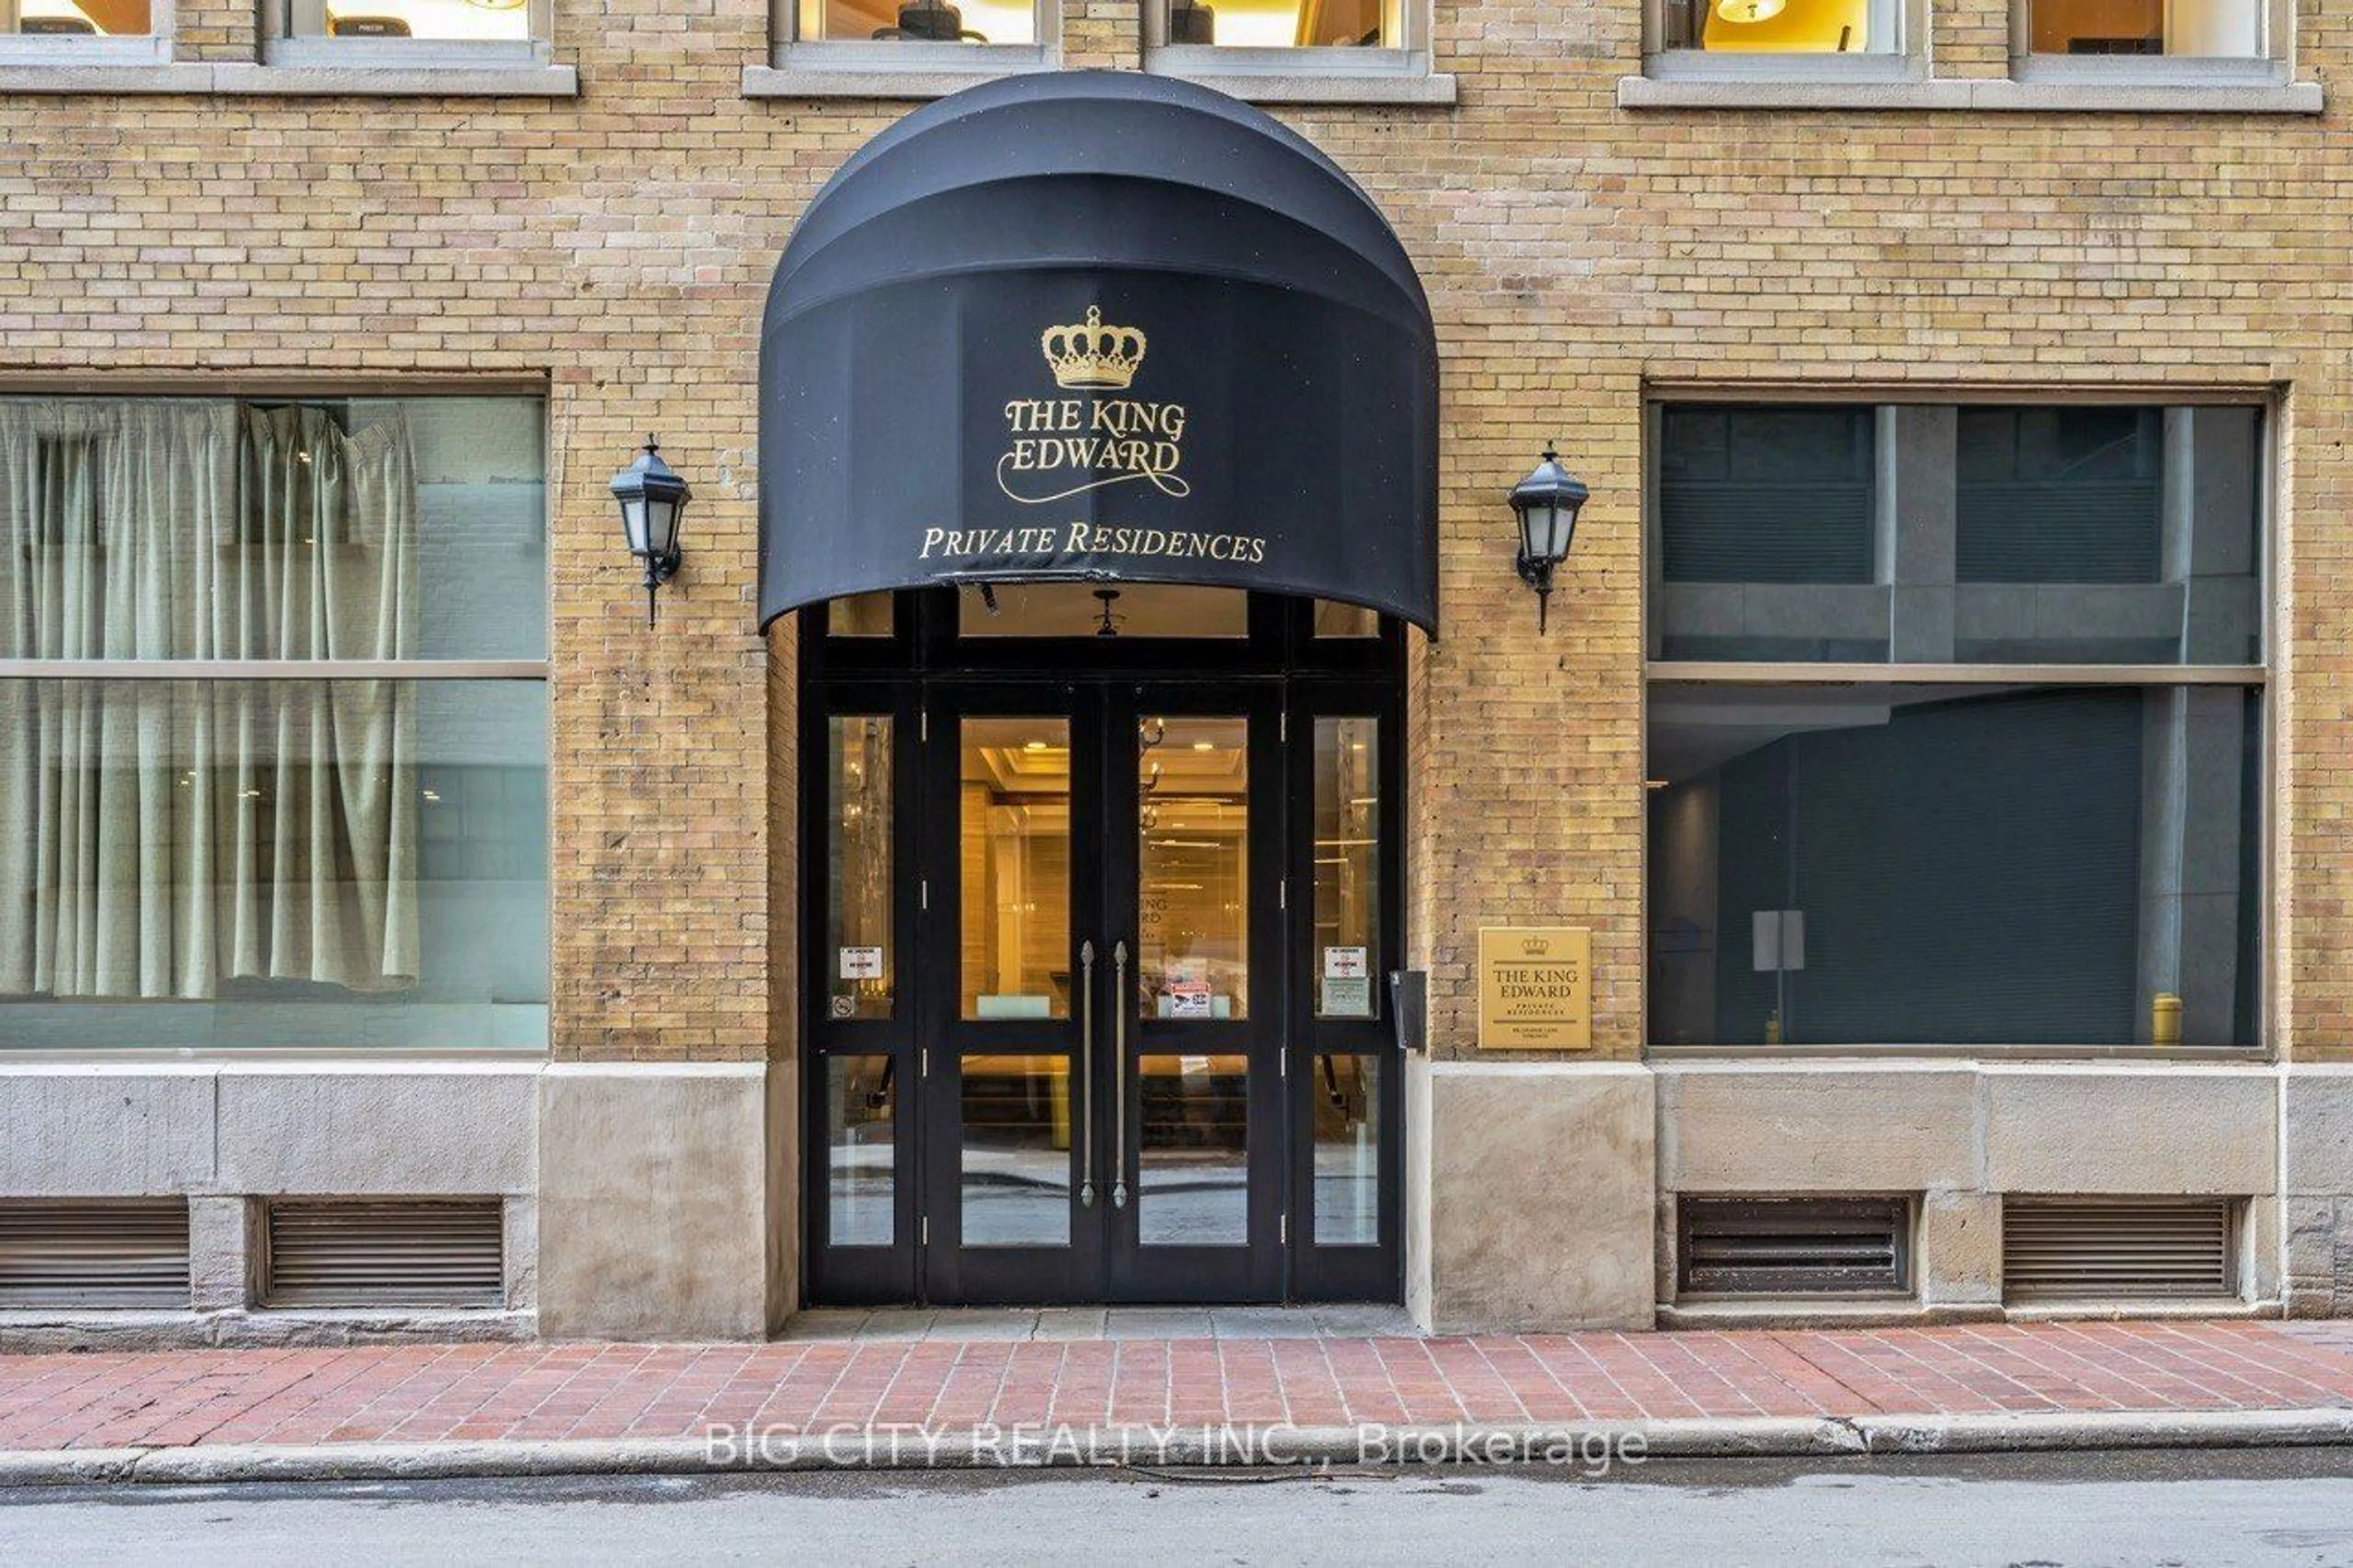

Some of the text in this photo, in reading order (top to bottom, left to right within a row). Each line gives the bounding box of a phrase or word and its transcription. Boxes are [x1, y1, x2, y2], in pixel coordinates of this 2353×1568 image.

[1004, 400, 1186, 441] THE KING
[919, 522, 1266, 564] PRIVATE RESIDENCES
[1493, 970, 1578, 983] THE KING
[1501, 985, 1571, 998] EDWARD
